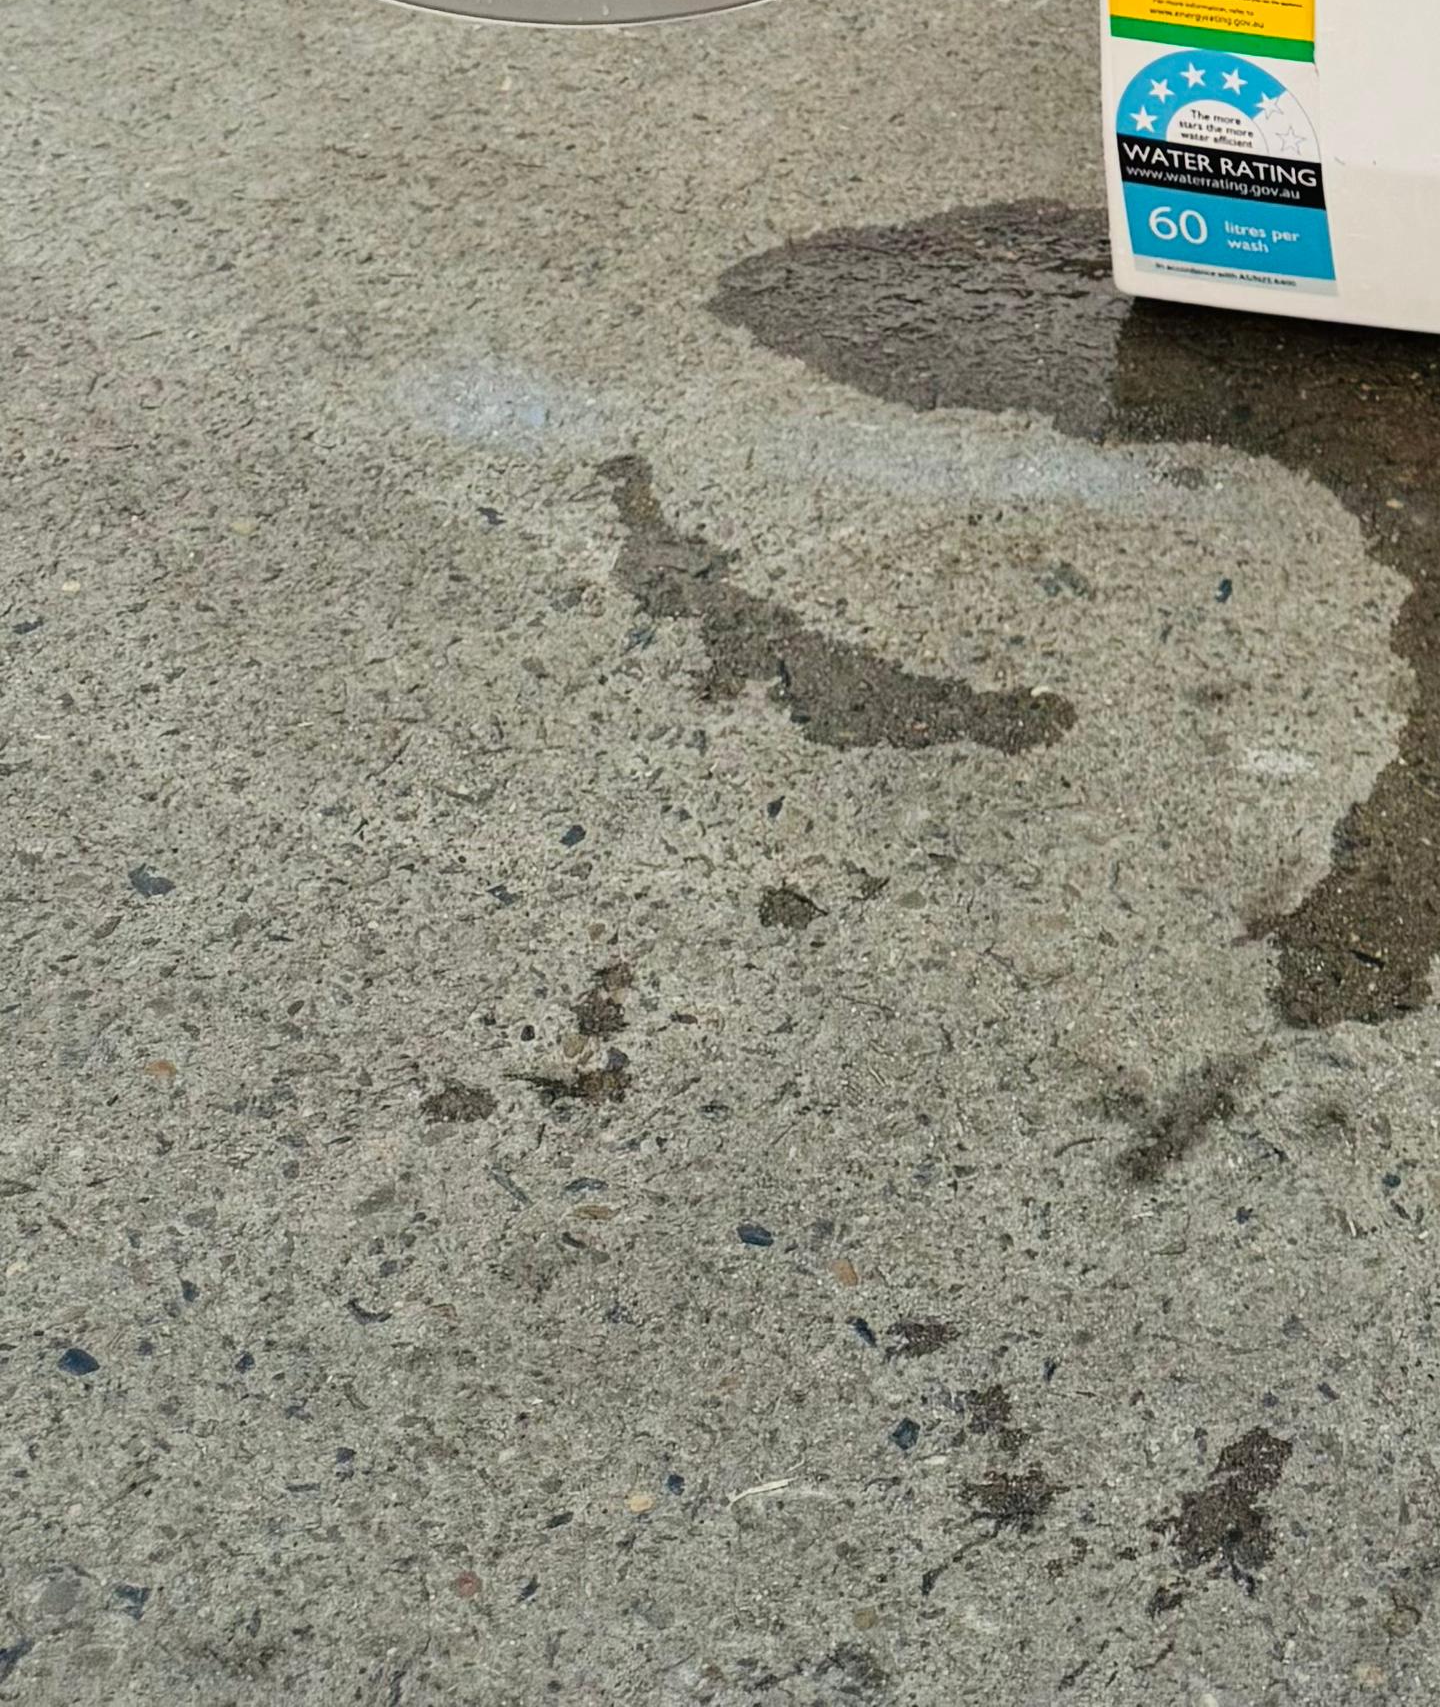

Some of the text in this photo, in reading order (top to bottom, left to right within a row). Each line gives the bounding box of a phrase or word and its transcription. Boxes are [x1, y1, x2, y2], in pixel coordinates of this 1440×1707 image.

[1191, 110, 1241, 125] The more
[1180, 121, 1253, 137] stars the more
[1181, 132, 1252, 148] water efficient
[1123, 142, 1317, 187] WATER RATING
[1126, 166, 1300, 200] www.waterrating.gov.au
[1149, 206, 1208, 244] 60
[1225, 221, 1300, 242] litres per
[1227, 239, 1268, 253] wash
